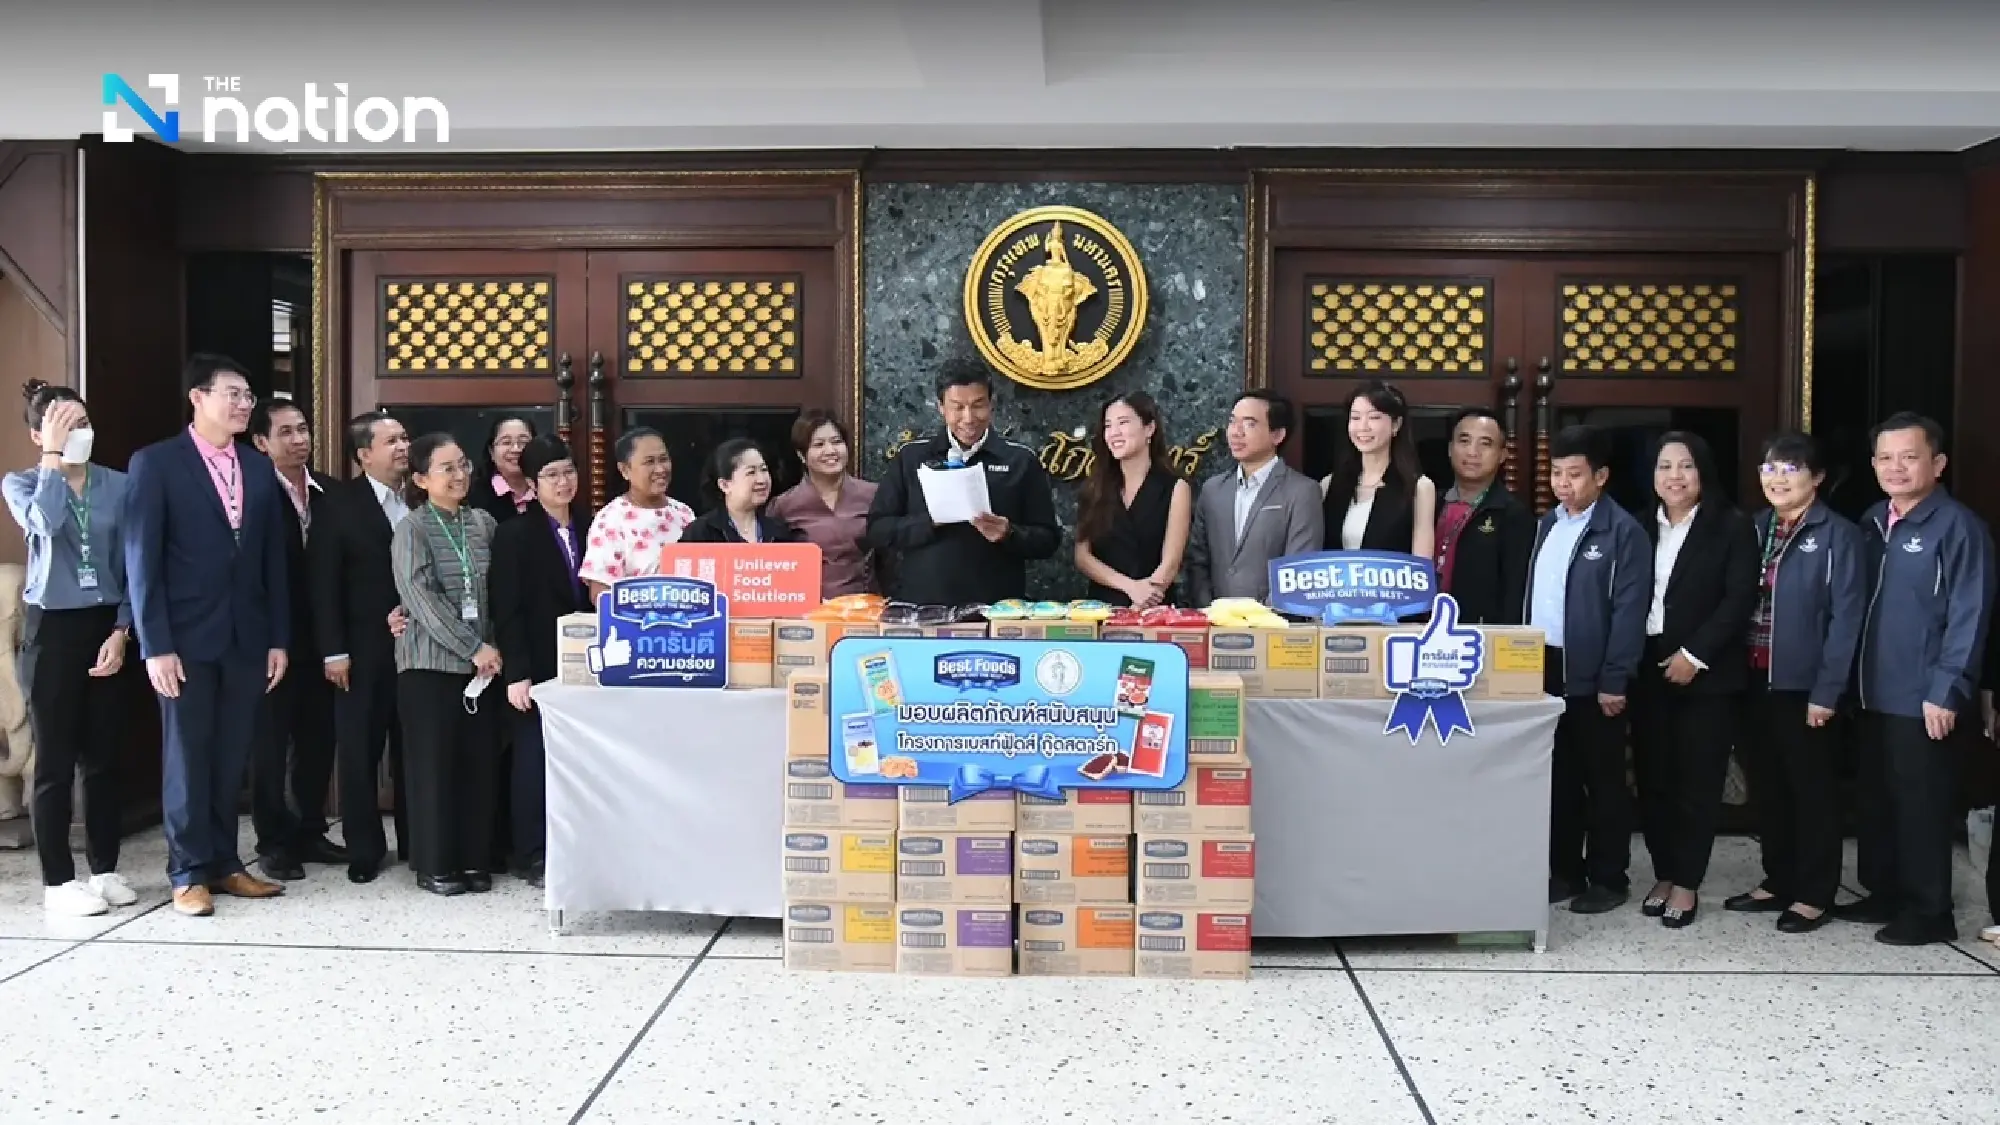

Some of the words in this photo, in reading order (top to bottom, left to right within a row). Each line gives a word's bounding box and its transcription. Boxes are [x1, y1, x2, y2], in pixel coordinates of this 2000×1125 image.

[990, 233, 1041, 284] กรุงเทพ
[1072, 233, 1123, 287] มหานคร
[733, 558, 799, 571] Unilever
[733, 573, 772, 587] Food
[1278, 564, 1344, 594] Best
[1348, 562, 1429, 592] Foods
[617, 586, 659, 605] Best
[662, 585, 710, 604] Foods
[733, 588, 806, 603] Solutions
[637, 629, 715, 654] การันตี
[637, 653, 715, 670] ความอร่อย
[938, 659, 973, 675] Best
[975, 658, 1016, 675] Foods
